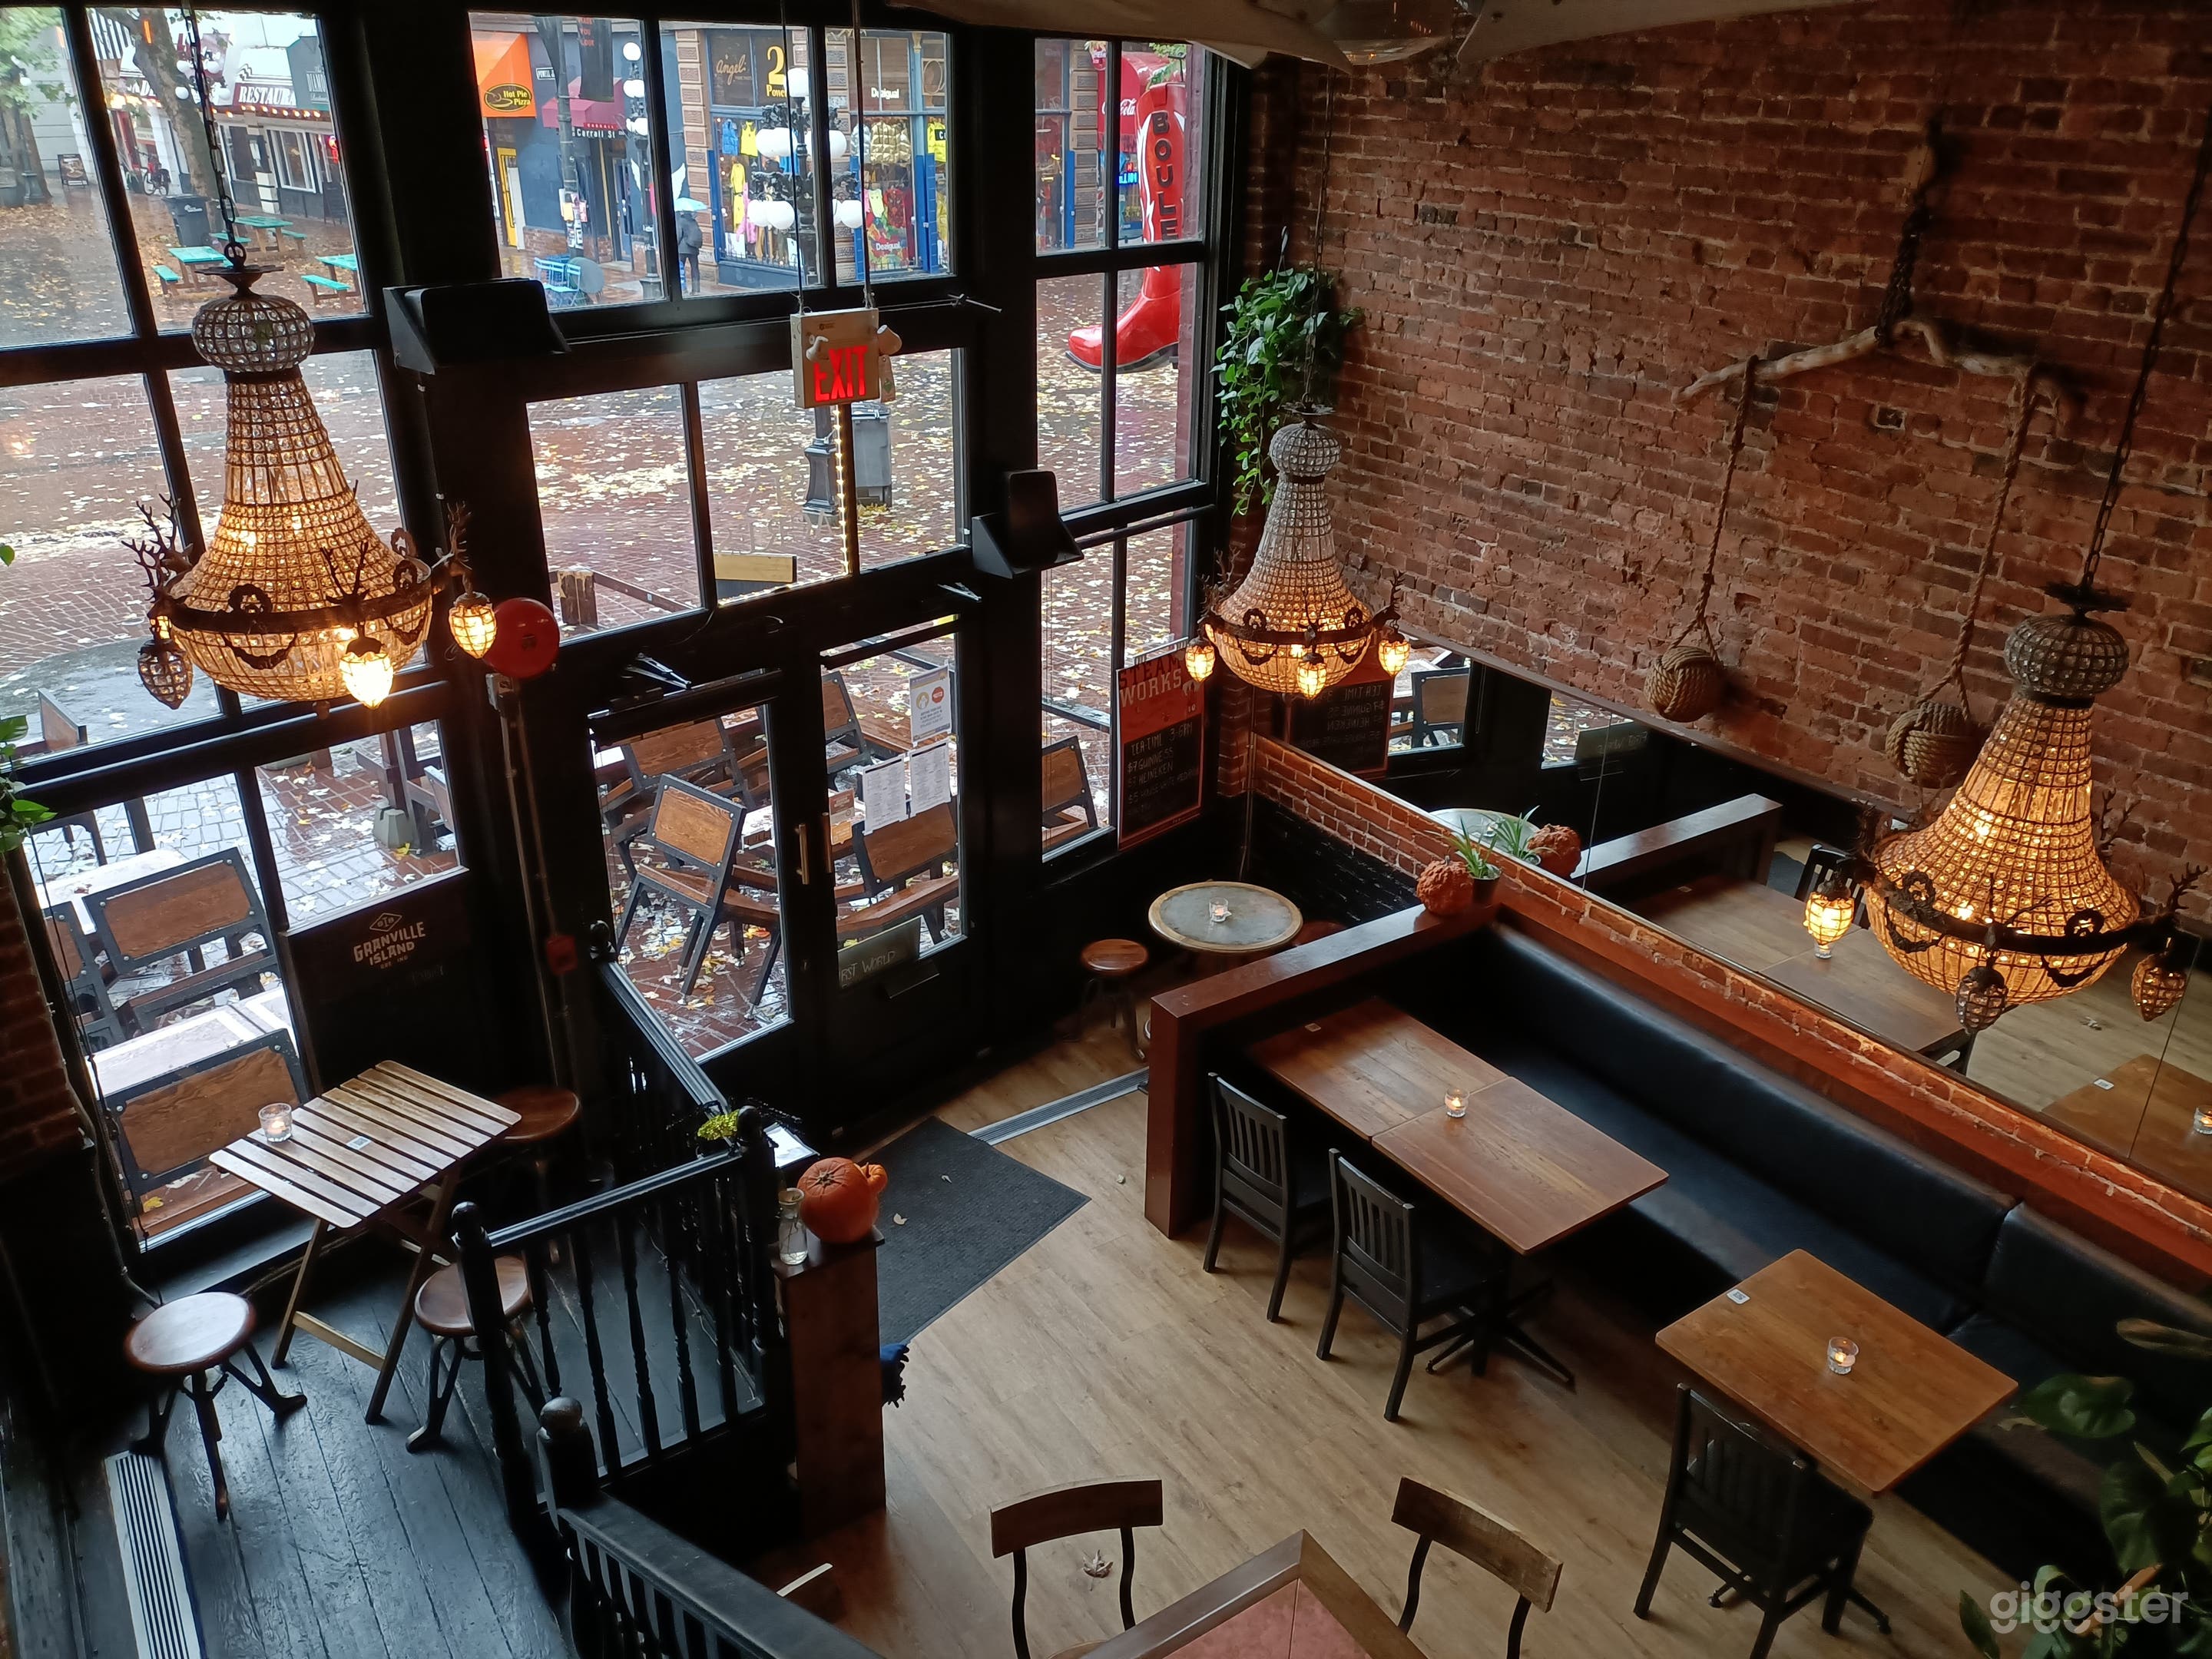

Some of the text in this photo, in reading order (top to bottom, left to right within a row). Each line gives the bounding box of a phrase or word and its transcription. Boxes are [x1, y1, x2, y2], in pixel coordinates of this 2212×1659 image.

[503, 90, 515, 98] Hot
[577, 128, 604, 138] Carrall
[1151, 111, 1178, 240] BOULE
[876, 241, 901, 253] Desigual
[813, 344, 869, 402] EXIT
[1119, 668, 1182, 707] WORKS
[353, 921, 426, 962] GRANVILLE
[369, 941, 416, 966] ISLAND
[862, 951, 896, 973] WORLD
